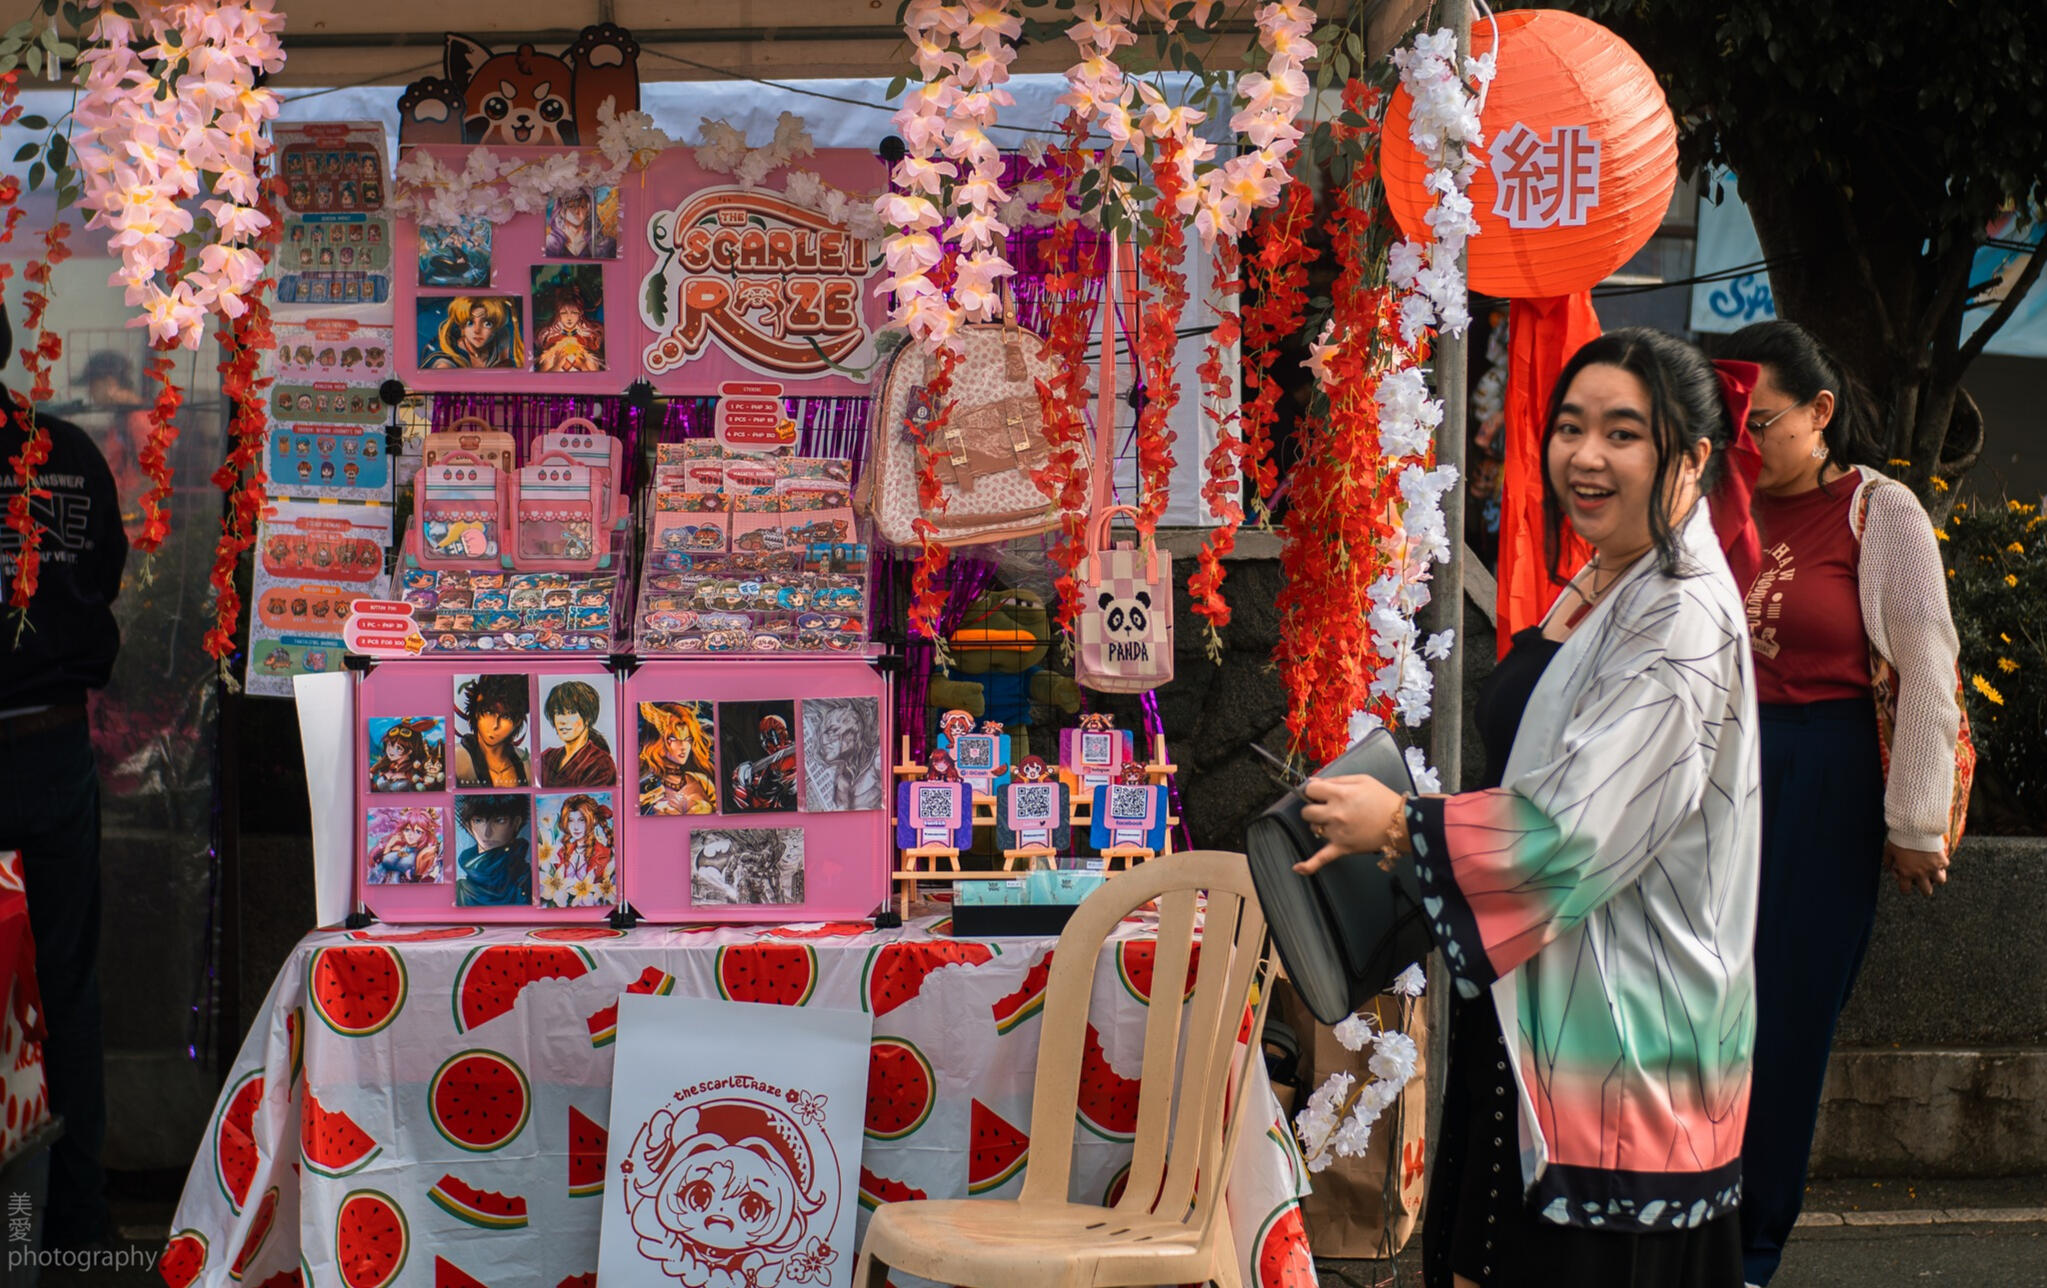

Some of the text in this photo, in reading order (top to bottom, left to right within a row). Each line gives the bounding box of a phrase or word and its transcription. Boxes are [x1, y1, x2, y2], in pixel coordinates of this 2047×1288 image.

[1500, 127, 1596, 222] 緋
[719, 211, 745, 224] THE
[1109, 642, 1149, 663] PANDA
